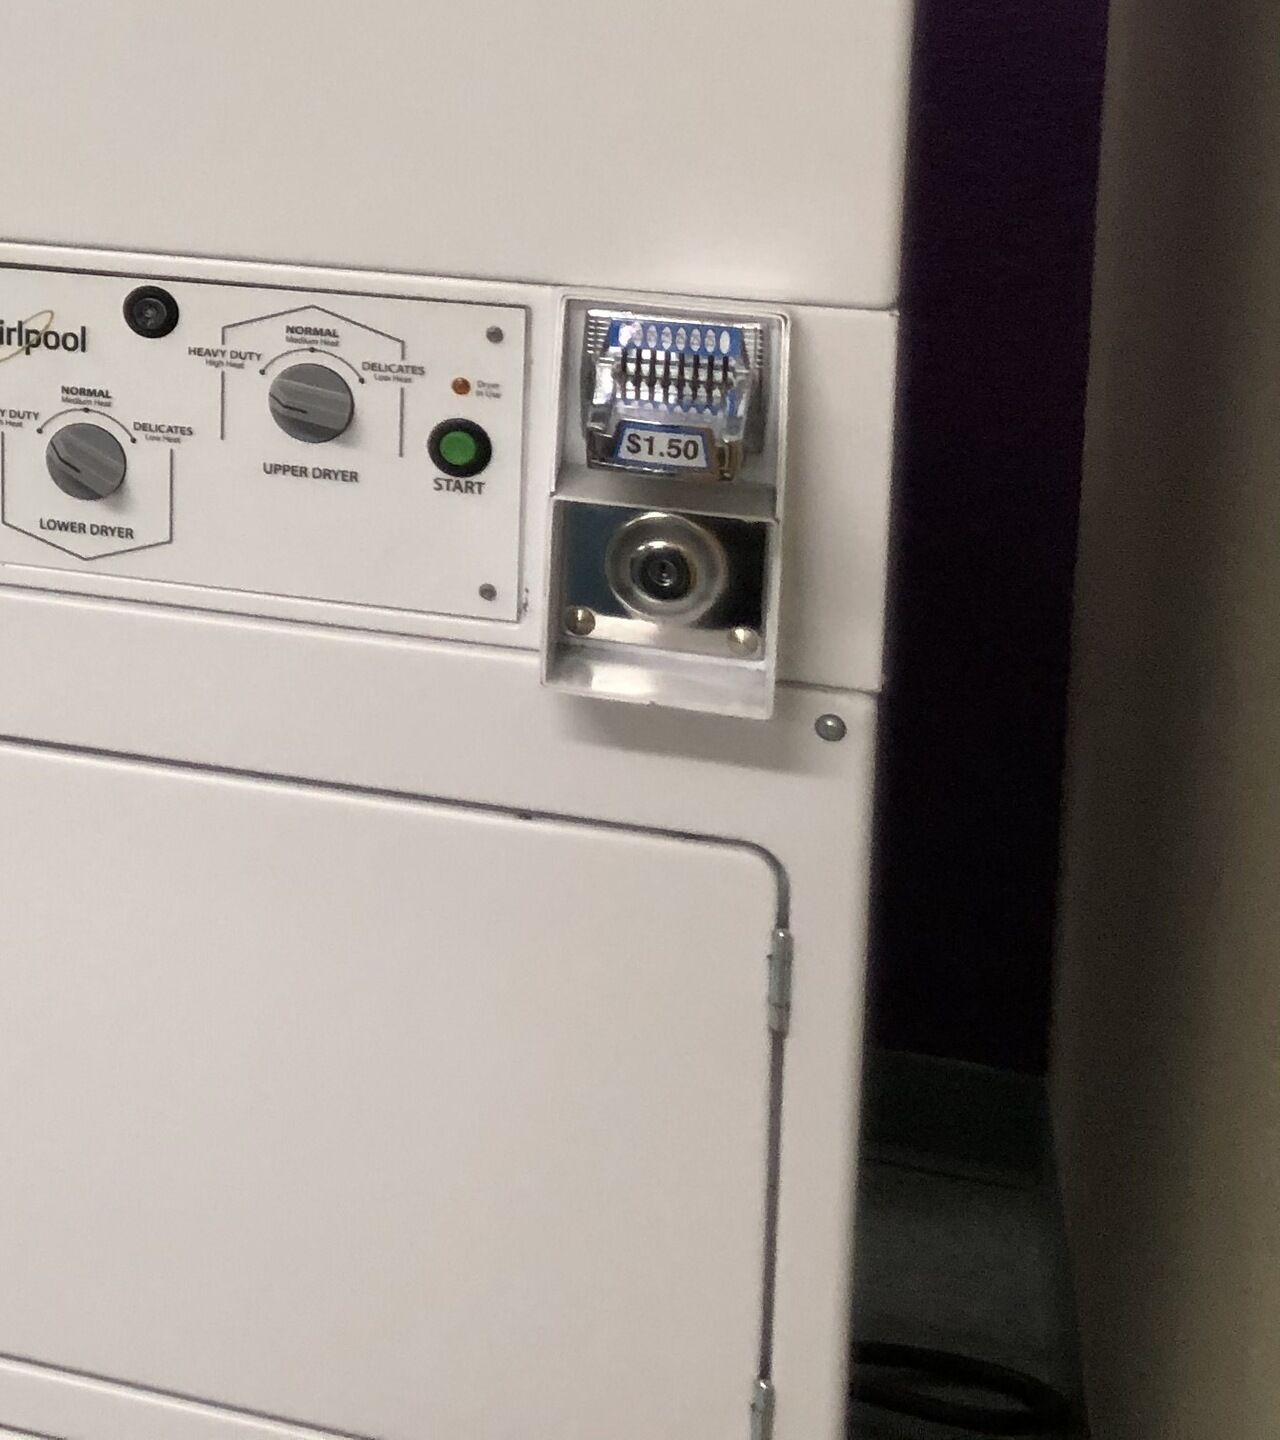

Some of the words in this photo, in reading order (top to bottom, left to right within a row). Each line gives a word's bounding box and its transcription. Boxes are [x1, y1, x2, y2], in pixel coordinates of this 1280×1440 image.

[286, 325, 339, 339] NORMAL
[187, 346, 227, 359] HEAVY
[230, 350, 263, 362] DUTY
[361, 361, 426, 376] DELICATES
[60, 385, 112, 399] NORMAL
[8, 408, 40, 421] DUTY
[133, 421, 194, 436] DELICATES
[625, 433, 699, 460] $1.50
[263, 461, 309, 478] UPPER
[312, 465, 359, 482] DRYER
[433, 477, 486, 495] START
[39, 517, 87, 535] LOWER
[89, 523, 134, 540] DRYER
